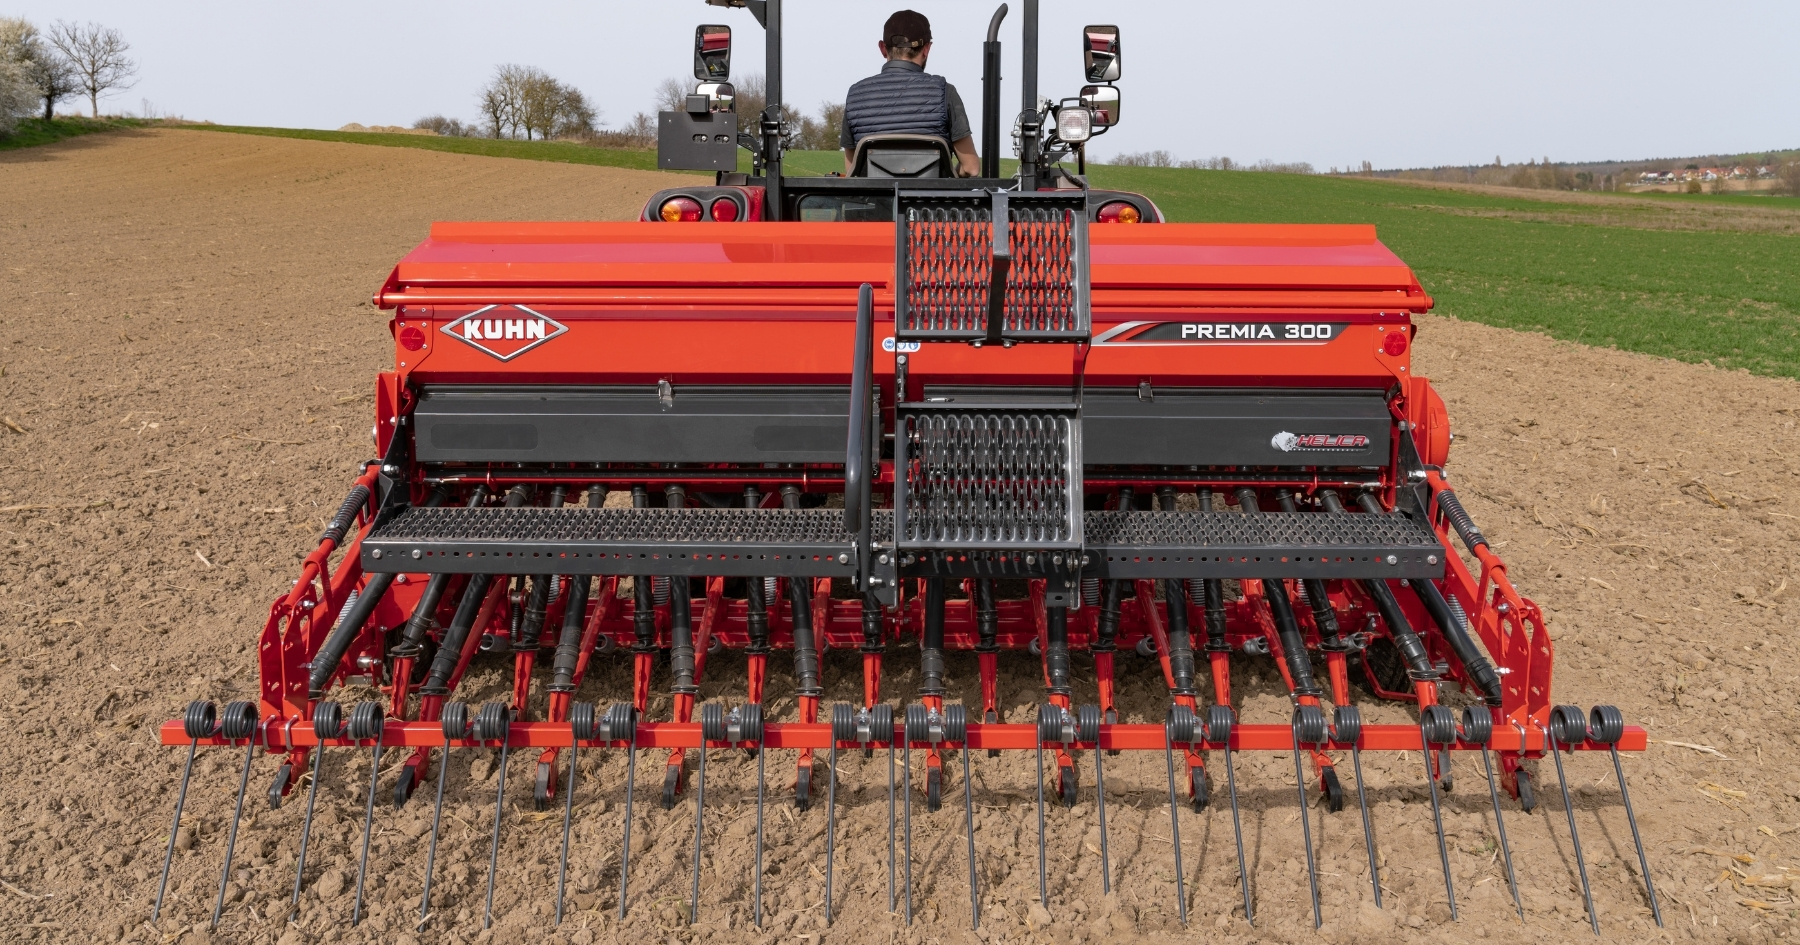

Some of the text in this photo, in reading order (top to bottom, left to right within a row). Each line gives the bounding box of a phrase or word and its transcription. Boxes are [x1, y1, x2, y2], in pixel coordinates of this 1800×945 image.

[464, 319, 546, 339] KUHN
[1181, 324, 1331, 339] PREMIA 300
[1297, 434, 1366, 447] HELICA
